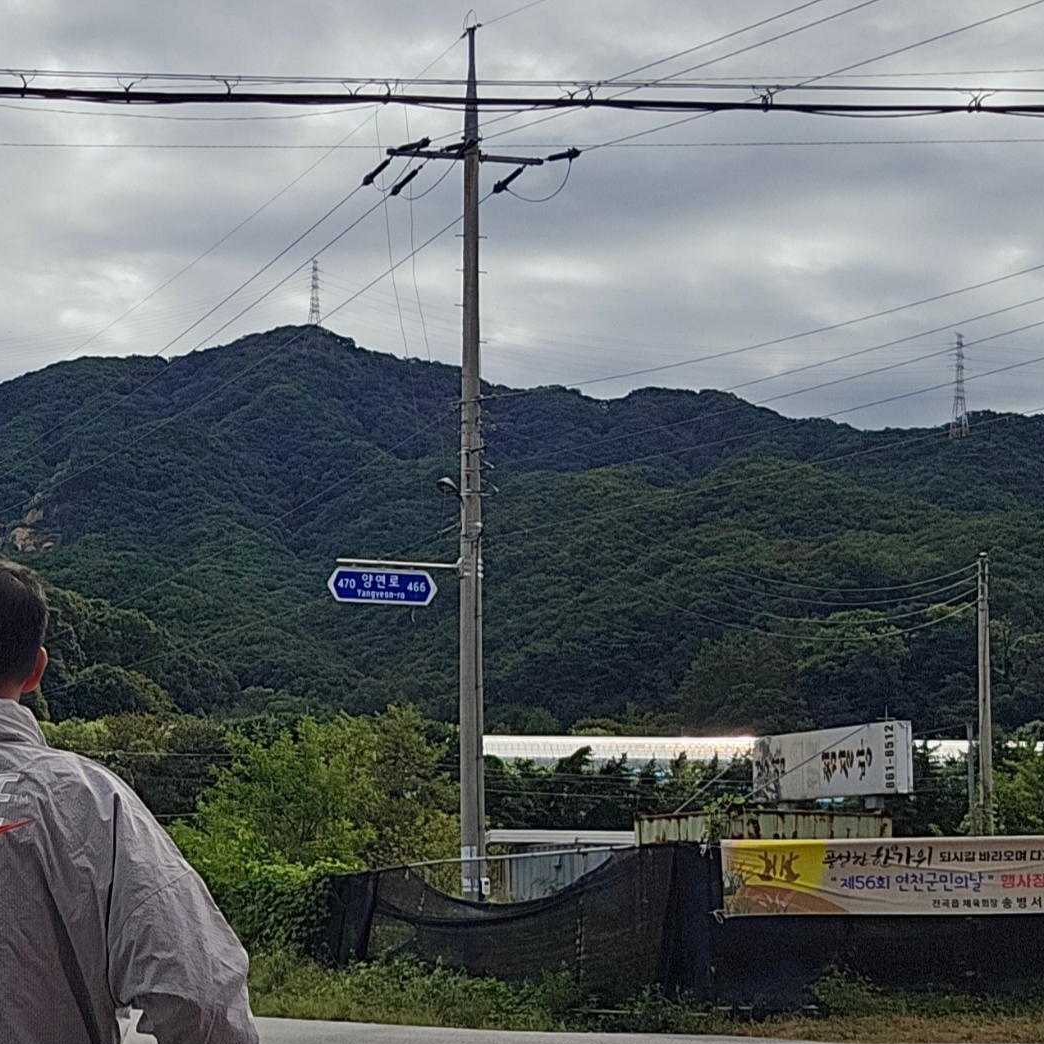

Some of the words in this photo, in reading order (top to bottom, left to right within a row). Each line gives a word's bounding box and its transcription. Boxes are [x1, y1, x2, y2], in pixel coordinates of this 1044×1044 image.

[337, 578, 356, 589] 470
[361, 573, 401, 589] 양연로
[406, 581, 426, 592] 466
[357, 588, 406, 600] Yangyeon-ro
[821, 737, 873, 783] 찜질방
[822, 849, 868, 869] 풍성한
[870, 845, 933, 868] 한가위
[939, 851, 976, 863] 되시길
[978, 850, 1027, 862] 바라오며
[1029, 849, 1044, 862] 다
[932, 898, 960, 908] 전곡읍
[962, 898, 999, 908] 체육회장
